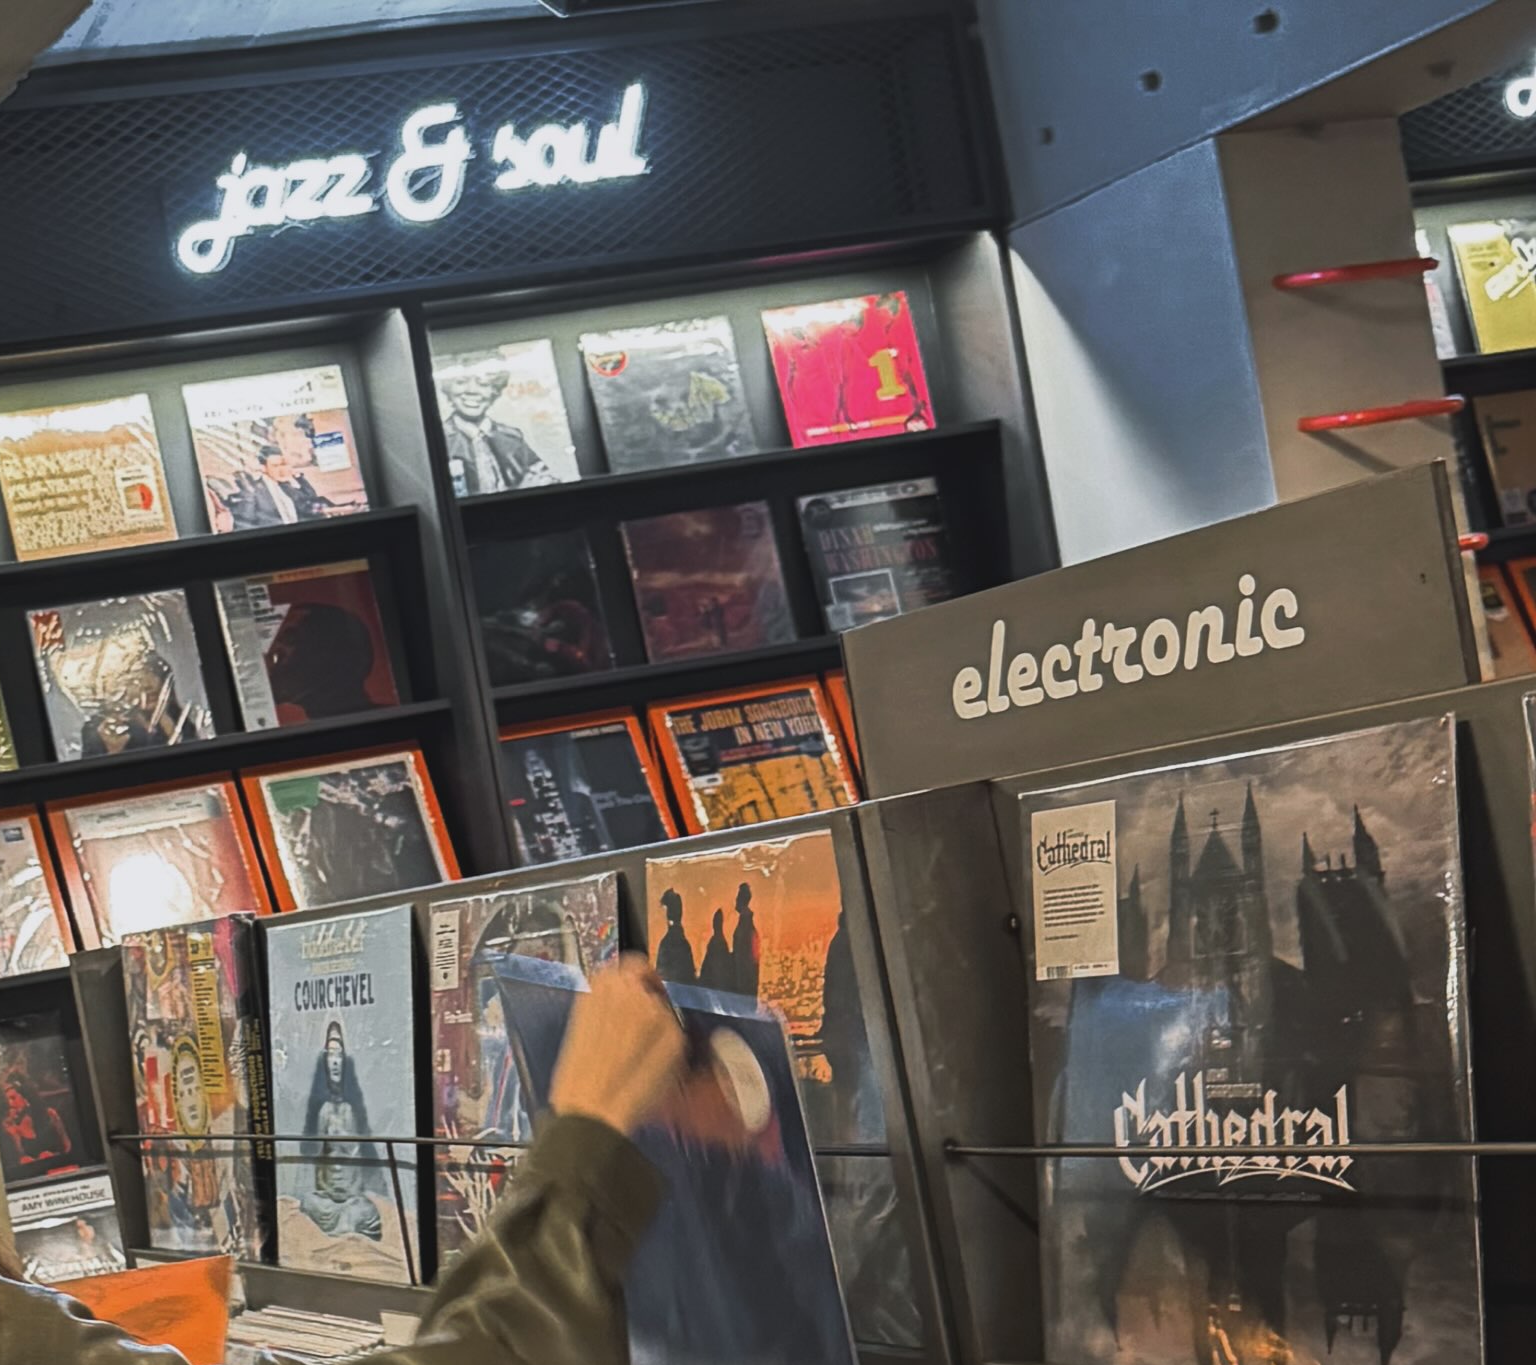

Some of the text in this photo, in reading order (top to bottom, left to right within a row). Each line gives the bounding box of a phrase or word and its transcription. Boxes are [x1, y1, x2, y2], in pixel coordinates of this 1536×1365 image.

[176, 80, 651, 275] jazz & soul
[868, 347, 907, 401] 1
[951, 574, 1306, 720] electronic
[699, 705, 739, 731] JOBIM
[755, 719, 785, 740] NEW
[1036, 830, 1112, 875] Cathedral
[294, 973, 375, 1012] COURCHEVEL
[1112, 1071, 1360, 1194] Cathedral
[20, 1187, 106, 1213] AMY WINEHOUSE
